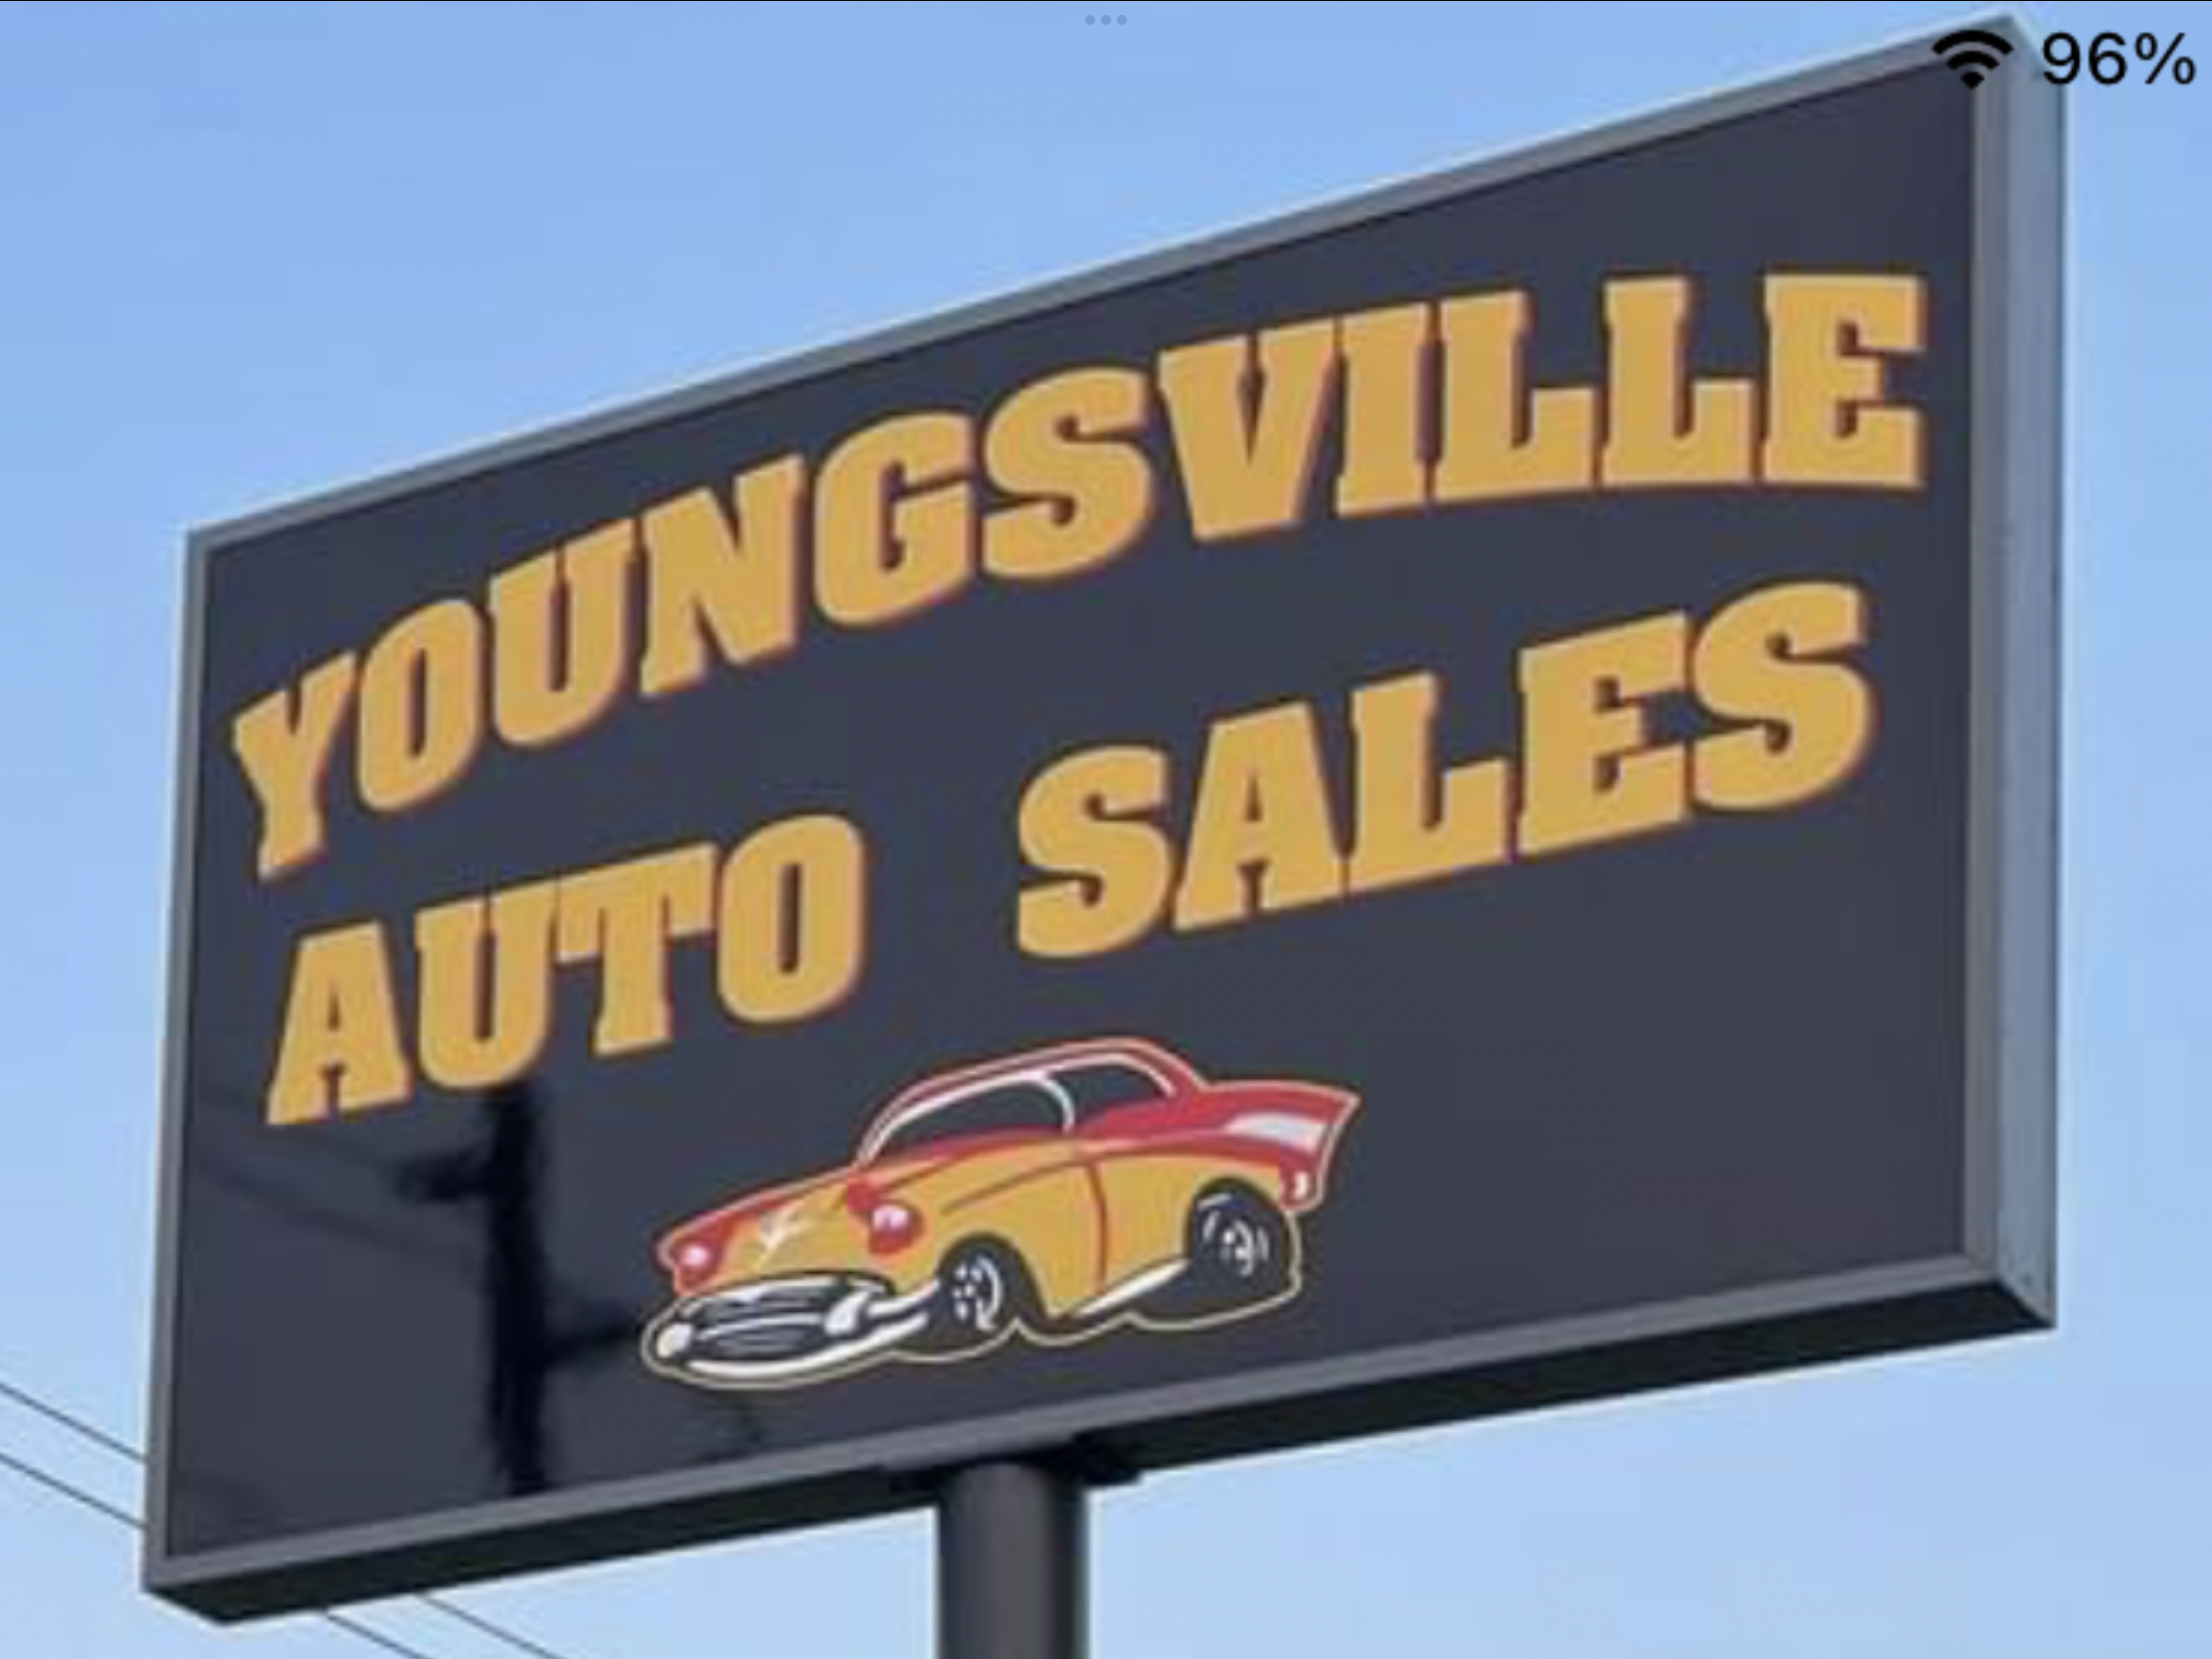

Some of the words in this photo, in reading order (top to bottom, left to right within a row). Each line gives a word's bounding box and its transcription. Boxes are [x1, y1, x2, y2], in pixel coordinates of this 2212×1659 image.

[231, 271, 1928, 879] YOUNGSVILLE
[265, 812, 870, 1126] AUTO
[1014, 580, 1878, 959] SALES
